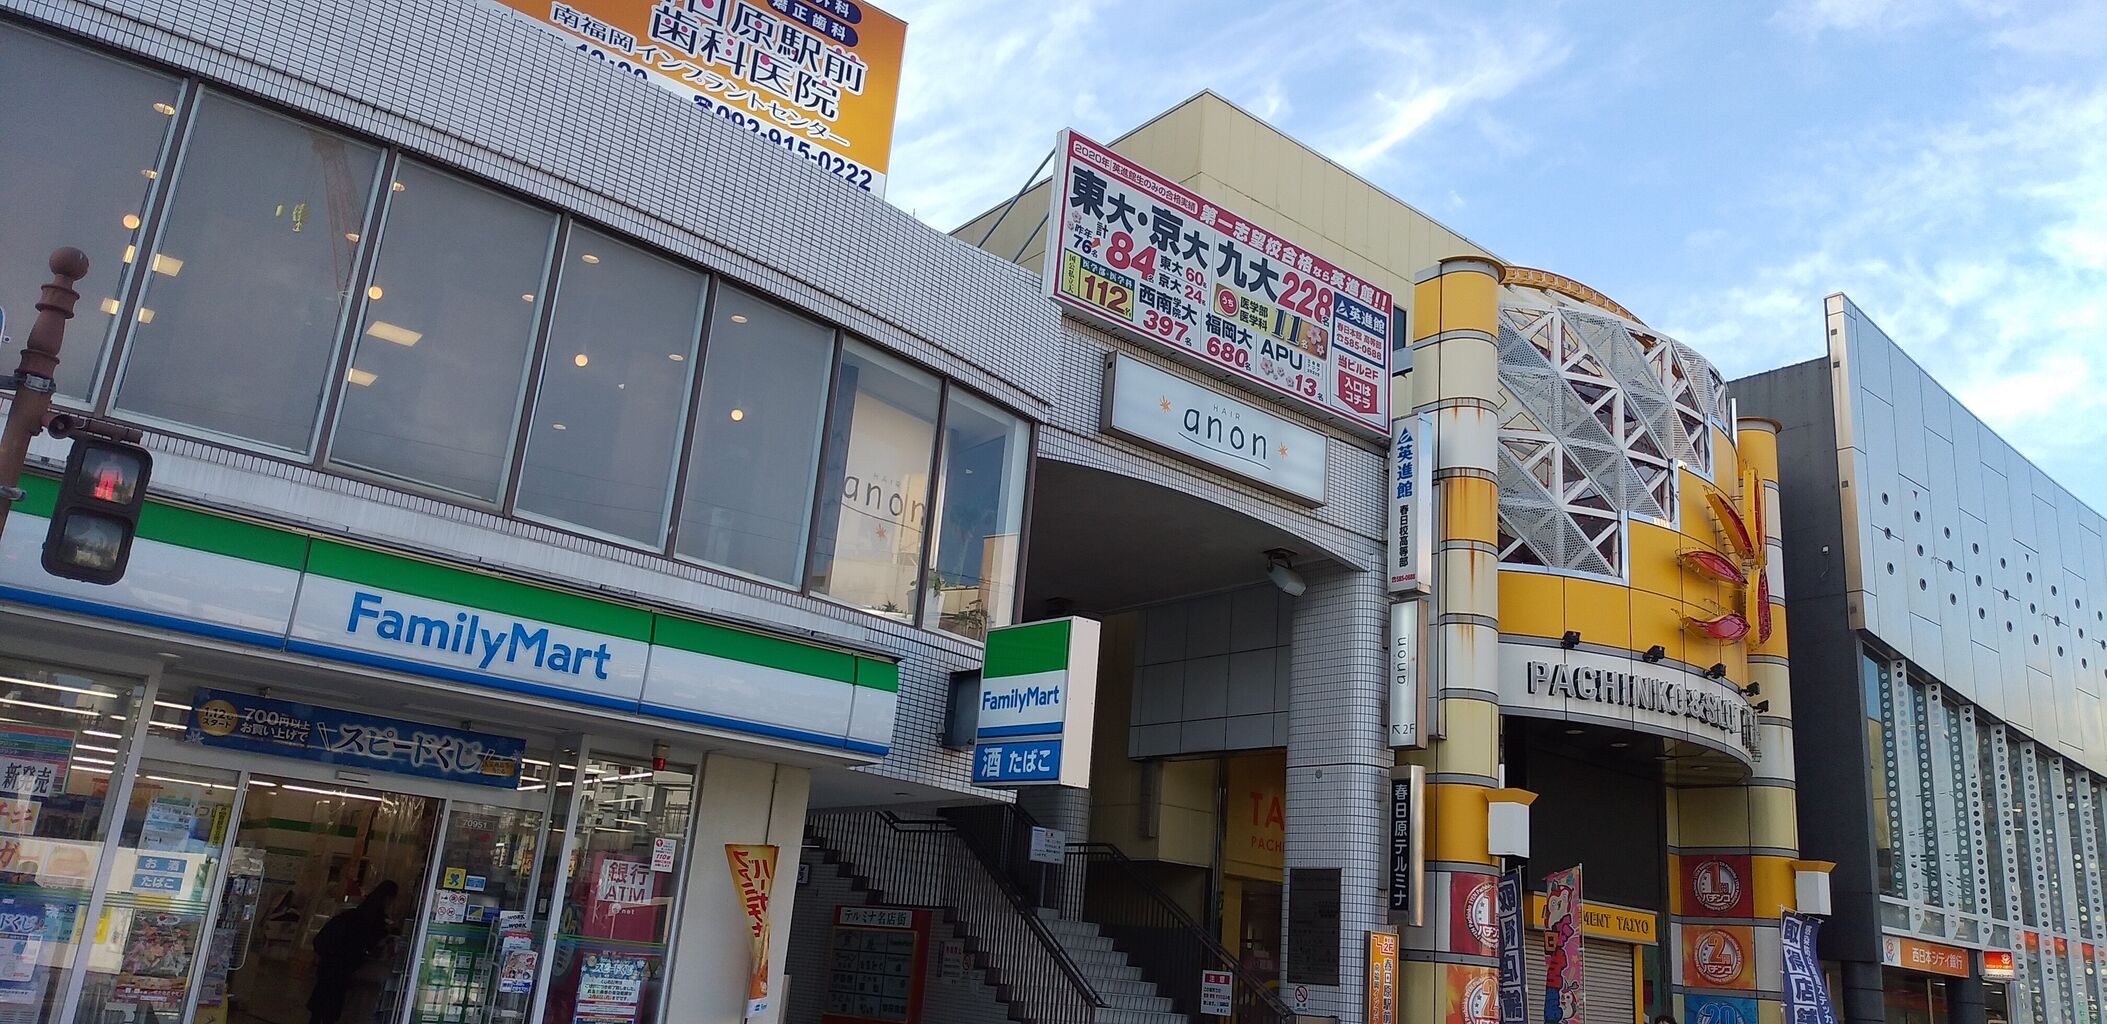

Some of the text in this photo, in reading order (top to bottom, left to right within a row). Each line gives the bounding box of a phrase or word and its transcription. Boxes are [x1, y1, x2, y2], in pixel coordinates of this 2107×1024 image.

[772, 0, 846, 41] 矯正歯科
[661, 0, 864, 92] 日原駅前
[652, 6, 839, 118] 歯科医院
[553, 4, 848, 145] 南福岡インプラントセンター
[1074, 143, 1196, 212] 2020年 英進館生のみの合格実績
[1070, 165, 1209, 269] 東大・京大
[1074, 223, 1093, 239] 昨年
[1096, 222, 1108, 239] 計
[1222, 296, 1234, 307] うち
[1240, 296, 1268, 318] 医学部
[1205, 312, 1252, 350] 福岡大
[1239, 310, 1267, 332] 医学科
[1349, 305, 1385, 335] 英進館
[1260, 339, 1303, 370] APU
[1338, 353, 1379, 380] 当ビル2F
[1344, 376, 1372, 397] 入口は
[1344, 390, 1371, 409] コチラ
[1213, 404, 1241, 420] HAIR
[1183, 408, 1267, 459] anon
[1397, 445, 1413, 499] 英進館
[843, 476, 925, 525] anon
[347, 591, 612, 681] FamilyMart
[1396, 636, 1407, 685] anon
[982, 685, 1060, 713] FamilyMart
[203, 717, 231, 729] スタート
[243, 707, 310, 731] 700円以上
[1403, 723, 1415, 735] 2F
[241, 721, 309, 743] お買い上げで
[335, 725, 480, 772] スピードくじ
[981, 746, 1051, 777] 酒 たばこ
[463, 820, 487, 829] 70951
[1394, 784, 1408, 906] 春日原テルミナ
[145, 858, 180, 872] お酒
[608, 861, 649, 886] 銀行
[141, 876, 174, 889] たばこ
[604, 885, 646, 903] ATM
[1702, 893, 1731, 902] パチンコ
[844, 911, 908, 926] テルミナ名店街
[1616, 915, 1650, 935] TAIYO
[1383, 943, 1393, 952] 2F
[1912, 947, 1963, 970] 西日本シティ銀行
[1703, 965, 1732, 973] パチンコ
